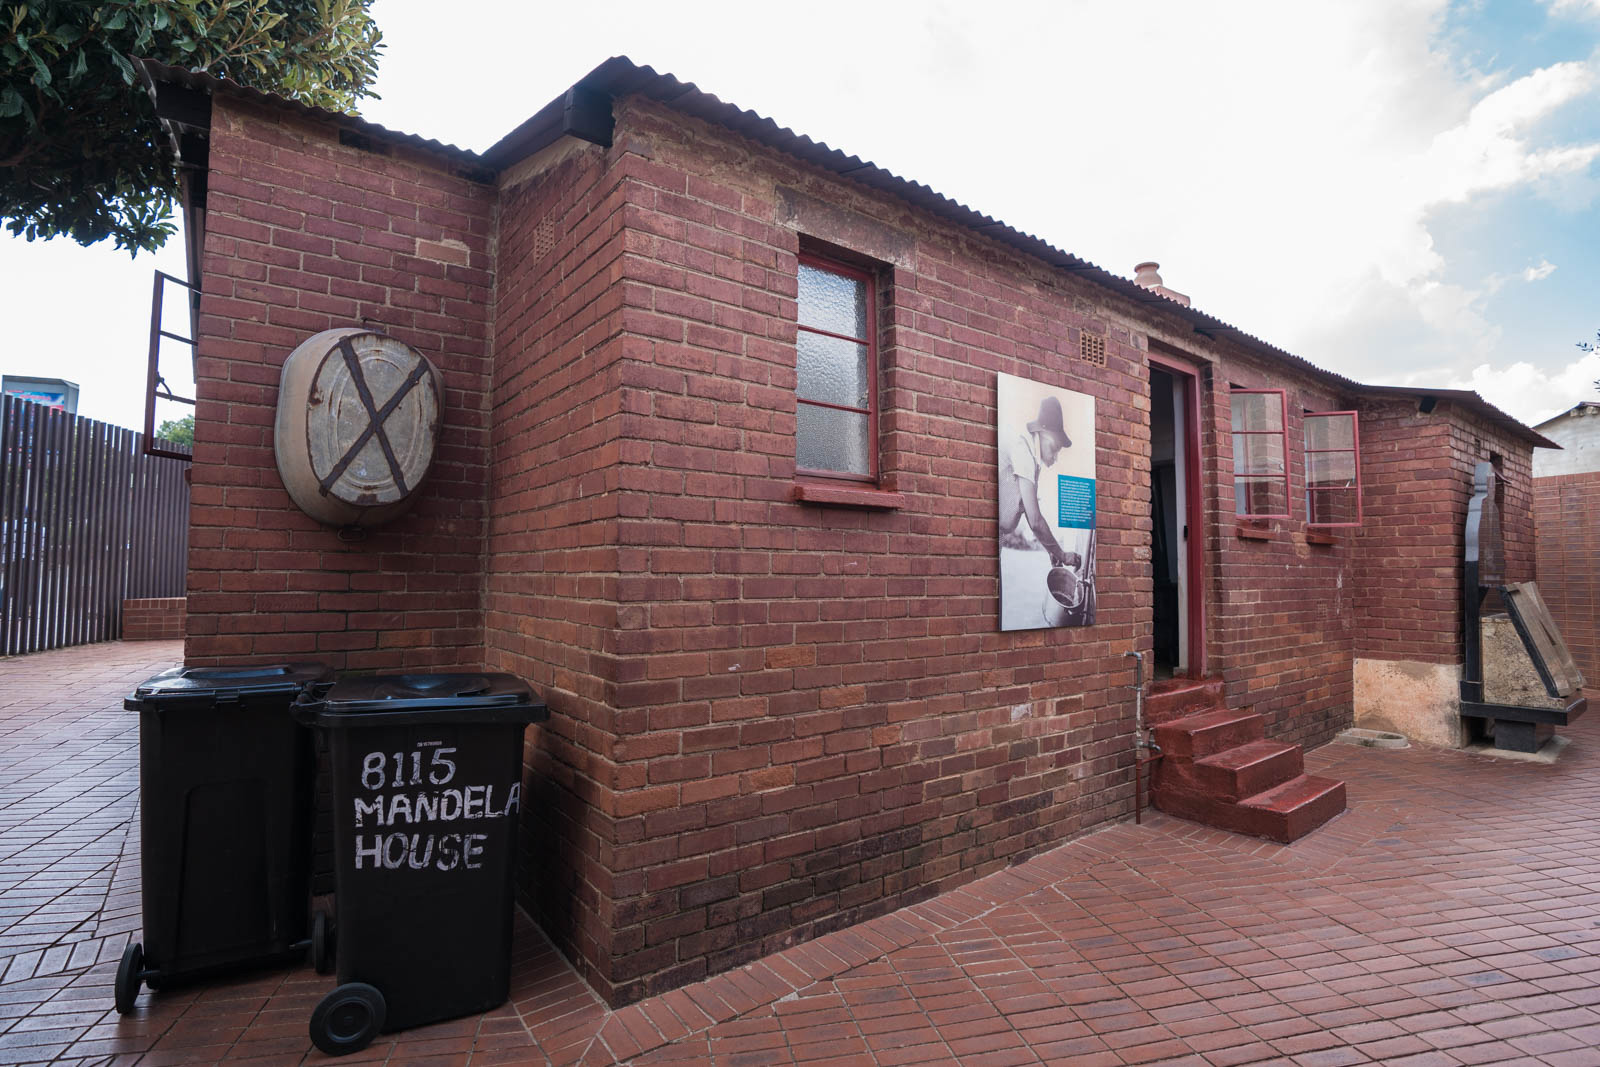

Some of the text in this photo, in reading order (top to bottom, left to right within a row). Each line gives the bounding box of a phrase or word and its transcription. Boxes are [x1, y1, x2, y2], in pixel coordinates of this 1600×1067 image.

[361, 747, 457, 790] 8115
[354, 781, 521, 828] MANDELA
[355, 832, 488, 871] HOUSE
